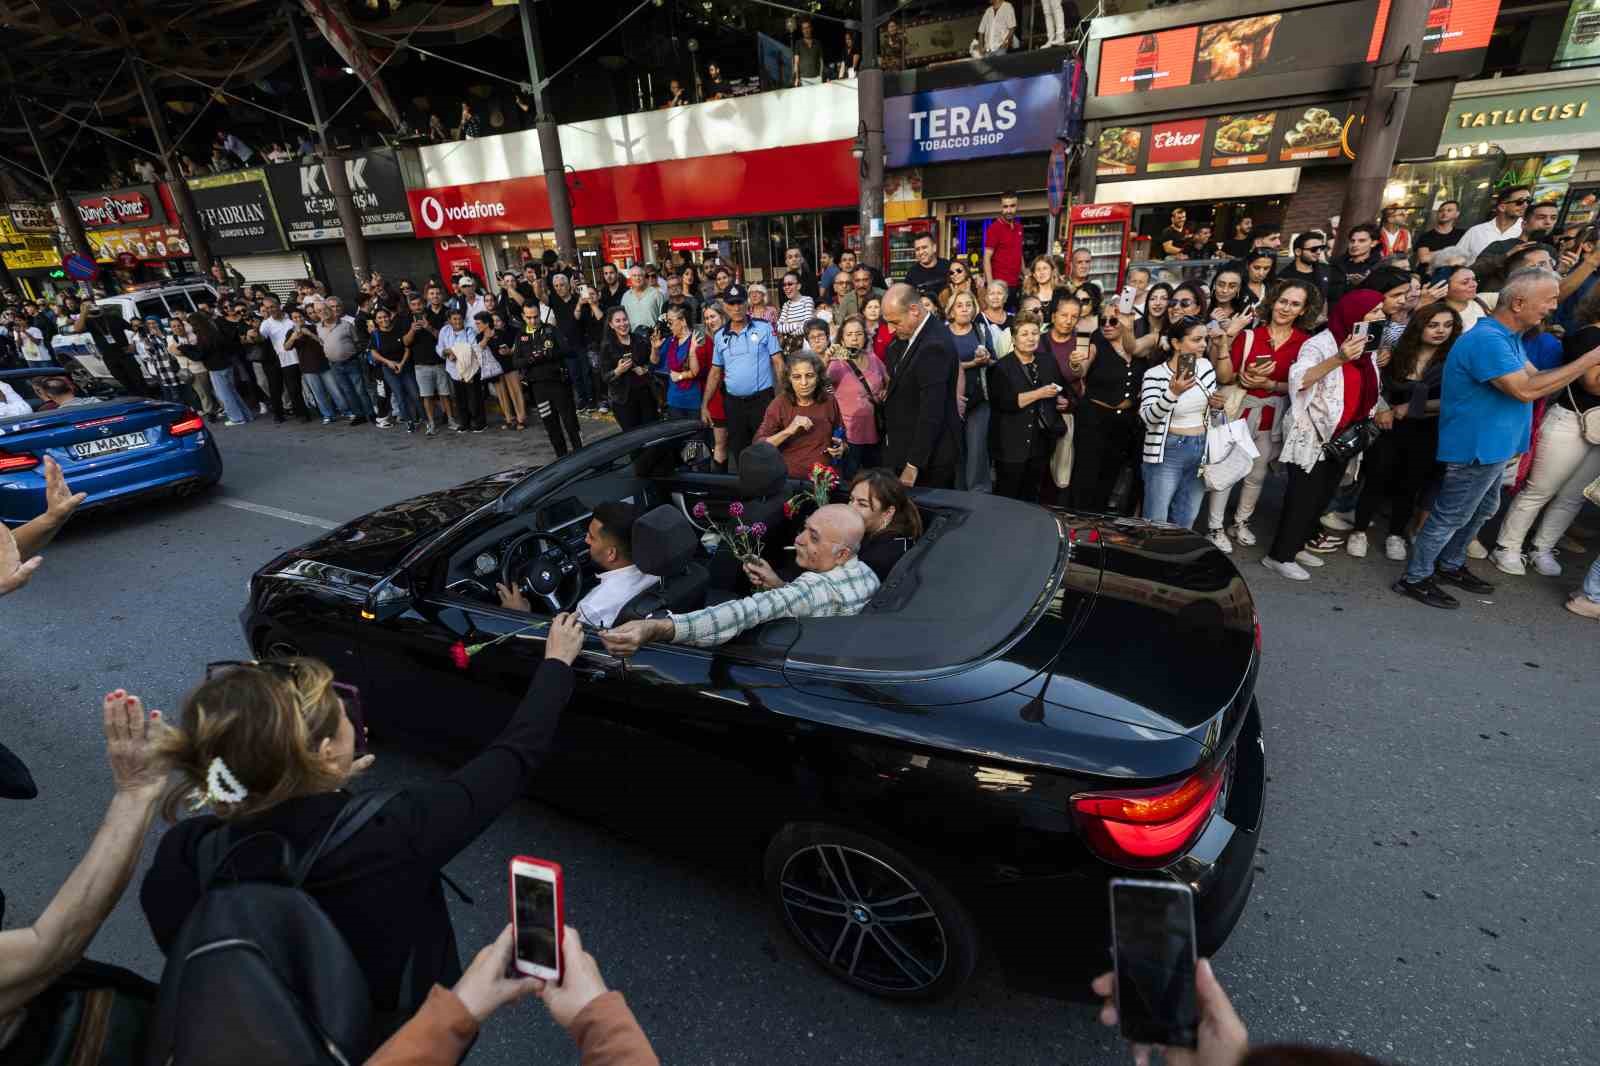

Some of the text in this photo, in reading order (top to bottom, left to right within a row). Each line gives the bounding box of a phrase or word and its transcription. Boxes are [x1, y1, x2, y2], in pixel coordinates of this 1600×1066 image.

[908, 99, 1017, 140] TERAS
[919, 132, 1004, 151] TOBACCO SHOP
[1154, 131, 1201, 149] Eker
[77, 199, 144, 225] Dünya Döner
[445, 199, 505, 220] vodafone
[76, 443, 91, 455] 07
[96, 436, 129, 450] MAM
[131, 433, 146, 445] 71
